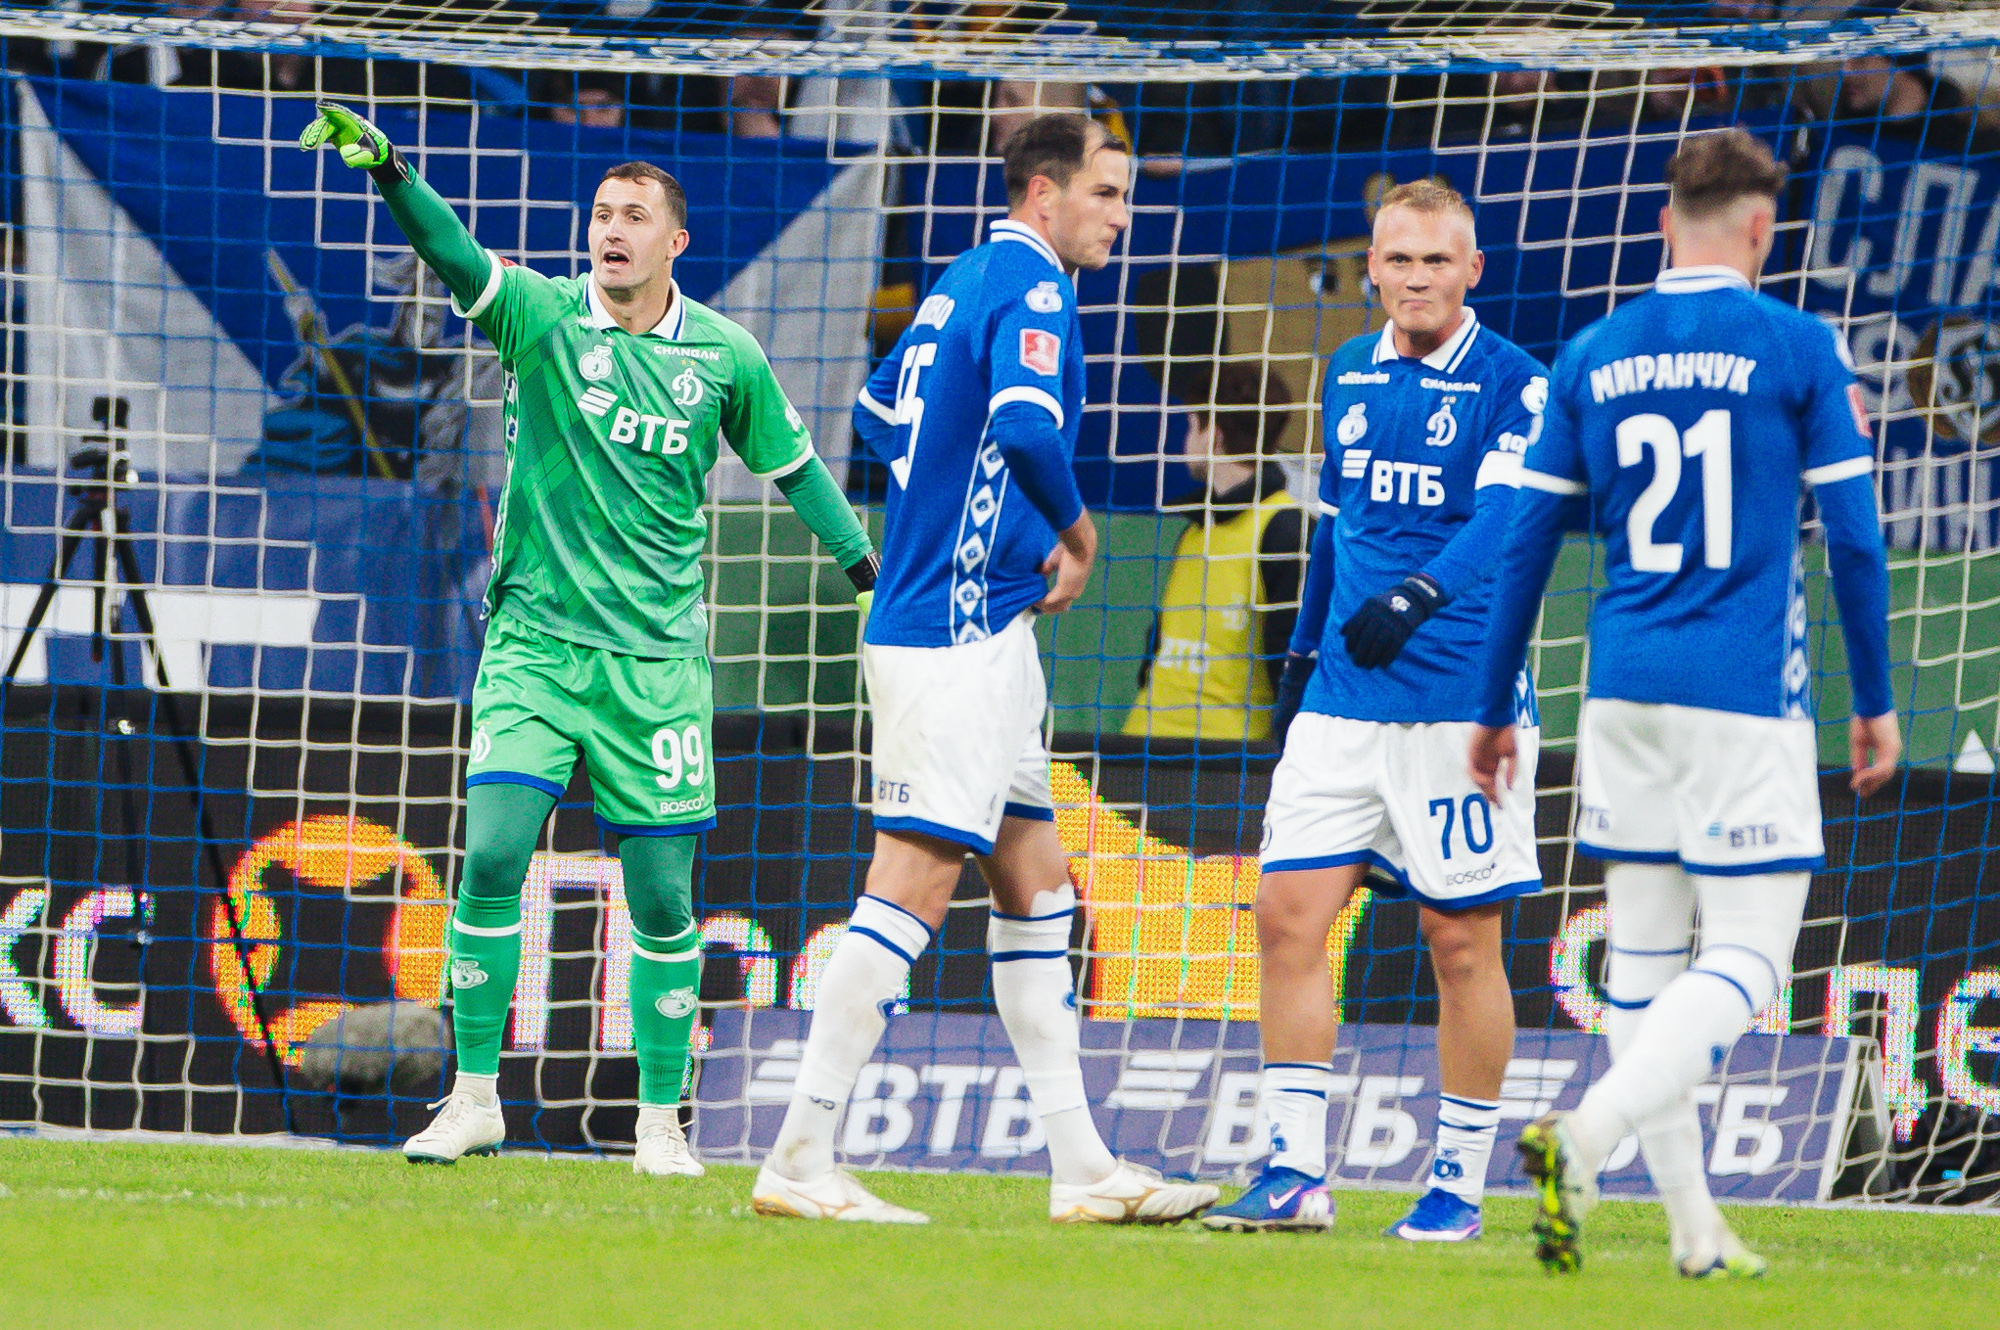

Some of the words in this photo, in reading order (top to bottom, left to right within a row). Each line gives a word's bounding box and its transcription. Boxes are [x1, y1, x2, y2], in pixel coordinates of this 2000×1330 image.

[653, 345, 720, 361] CHANGAN
[1590, 352, 1757, 403] МИРАНЧУК
[609, 406, 690, 455] ВТБ
[1370, 459, 1445, 506] ВТБ
[1616, 409, 1733, 573] 21
[651, 725, 704, 788] 99
[660, 798, 703, 814] BOSCO
[878, 780, 910, 803] ВТБ
[1429, 793, 1493, 860] 70
[1729, 823, 1779, 848] ВТБ
[1446, 868, 1493, 887] BOSCO
[842, 1062, 1047, 1158] ВТБ
[1203, 1073, 1424, 1167] ВБ
